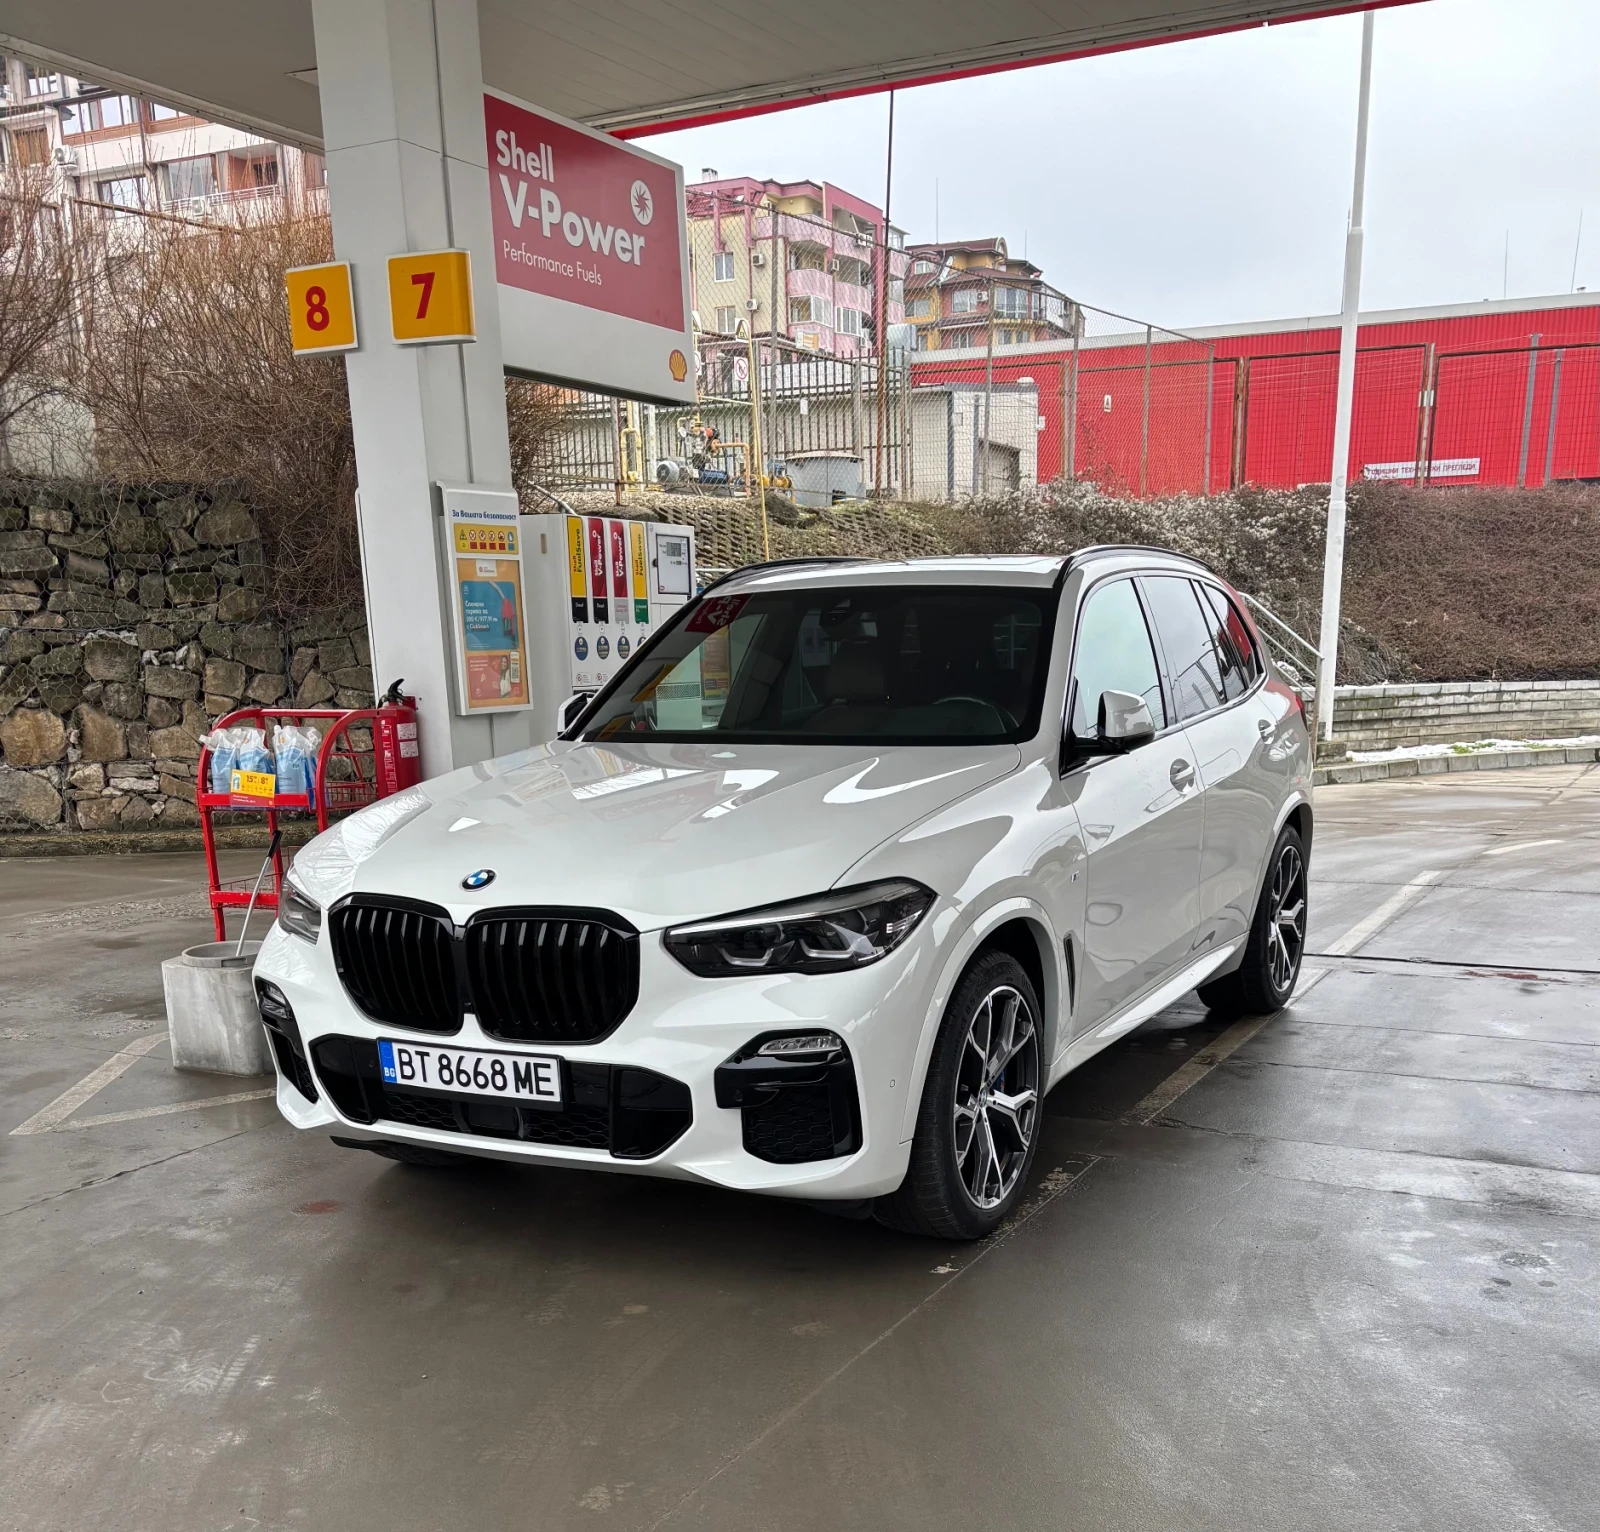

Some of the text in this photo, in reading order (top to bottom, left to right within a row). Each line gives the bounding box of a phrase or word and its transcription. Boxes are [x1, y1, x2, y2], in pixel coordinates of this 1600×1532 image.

[496, 129, 555, 183] Shell
[499, 173, 646, 266] V-Power
[503, 239, 602, 286] Performance Fuels
[305, 286, 330, 332] 8
[411, 272, 436, 319] 7
[1443, 463, 1476, 472] ПРЕГЛЕДИ
[452, 510, 460, 518] За
[460, 510, 483, 519] Вашата
[383, 1066, 396, 1078] BG
[397, 1048, 555, 1096] BT 8668 ME
